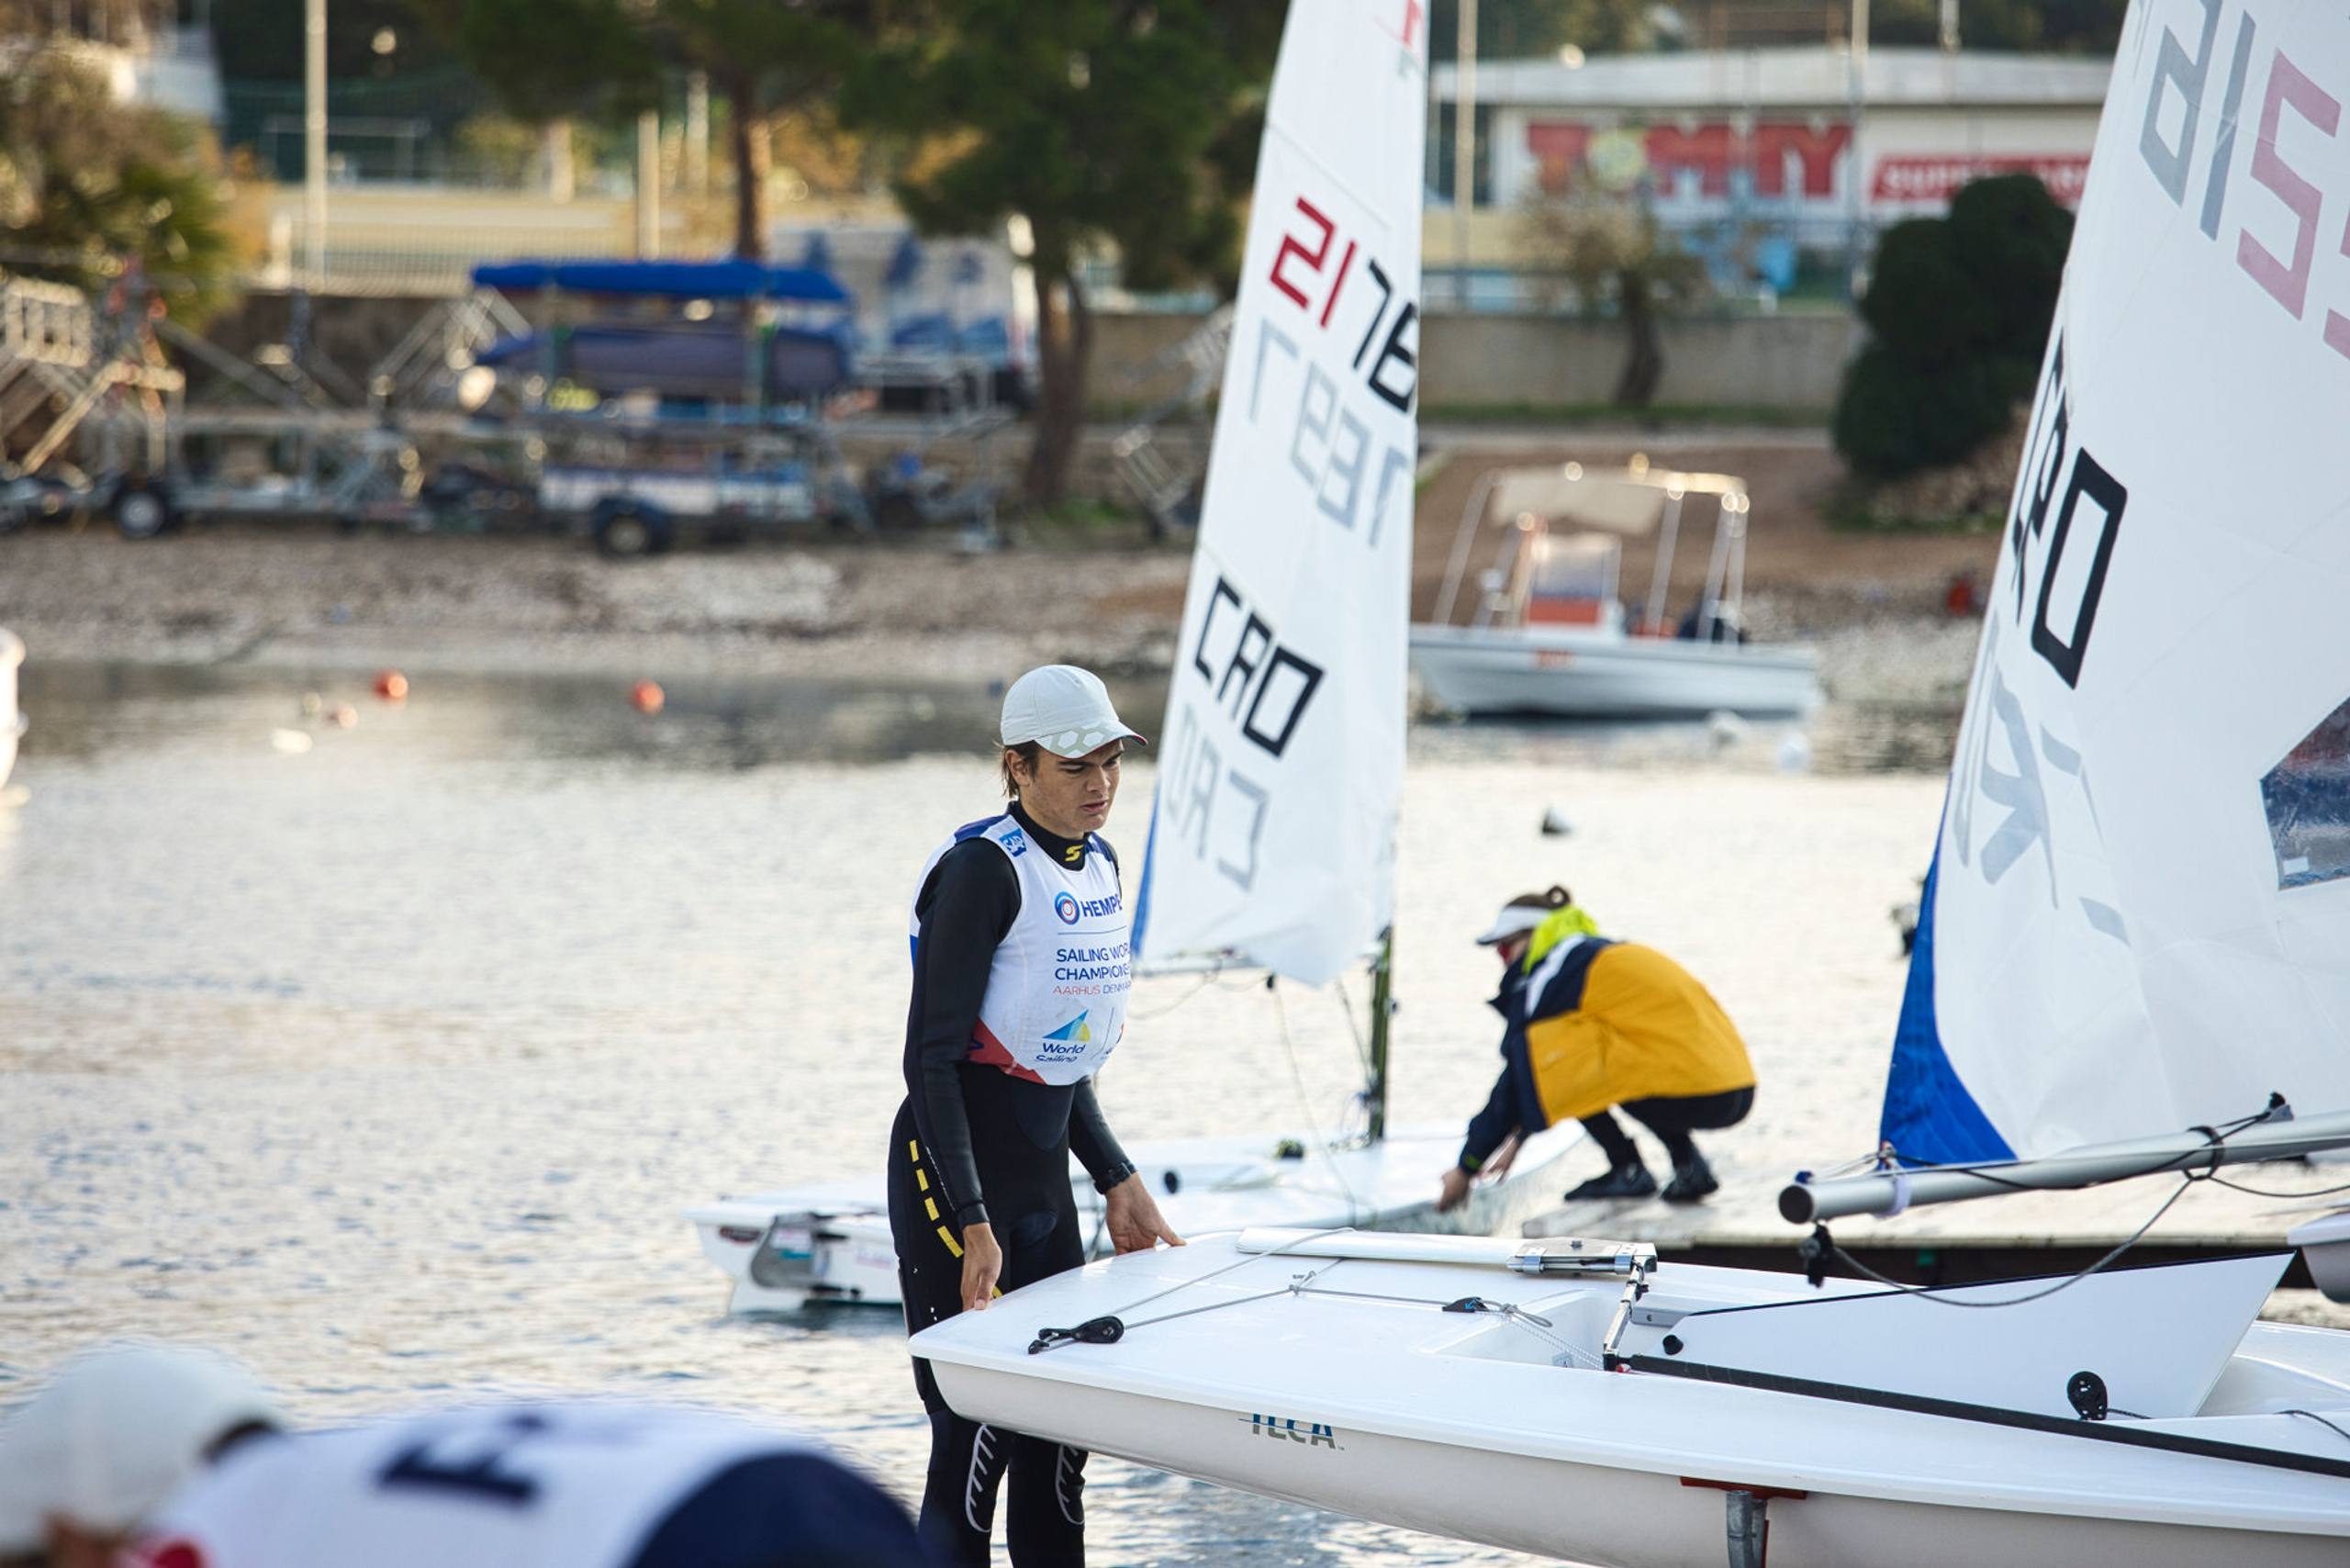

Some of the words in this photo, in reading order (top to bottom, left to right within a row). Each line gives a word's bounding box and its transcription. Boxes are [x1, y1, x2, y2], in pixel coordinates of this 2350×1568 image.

[1056, 947, 1109, 963] SAILING
[1052, 984, 1101, 996] AARHUS
[1042, 1042, 1087, 1055] World
